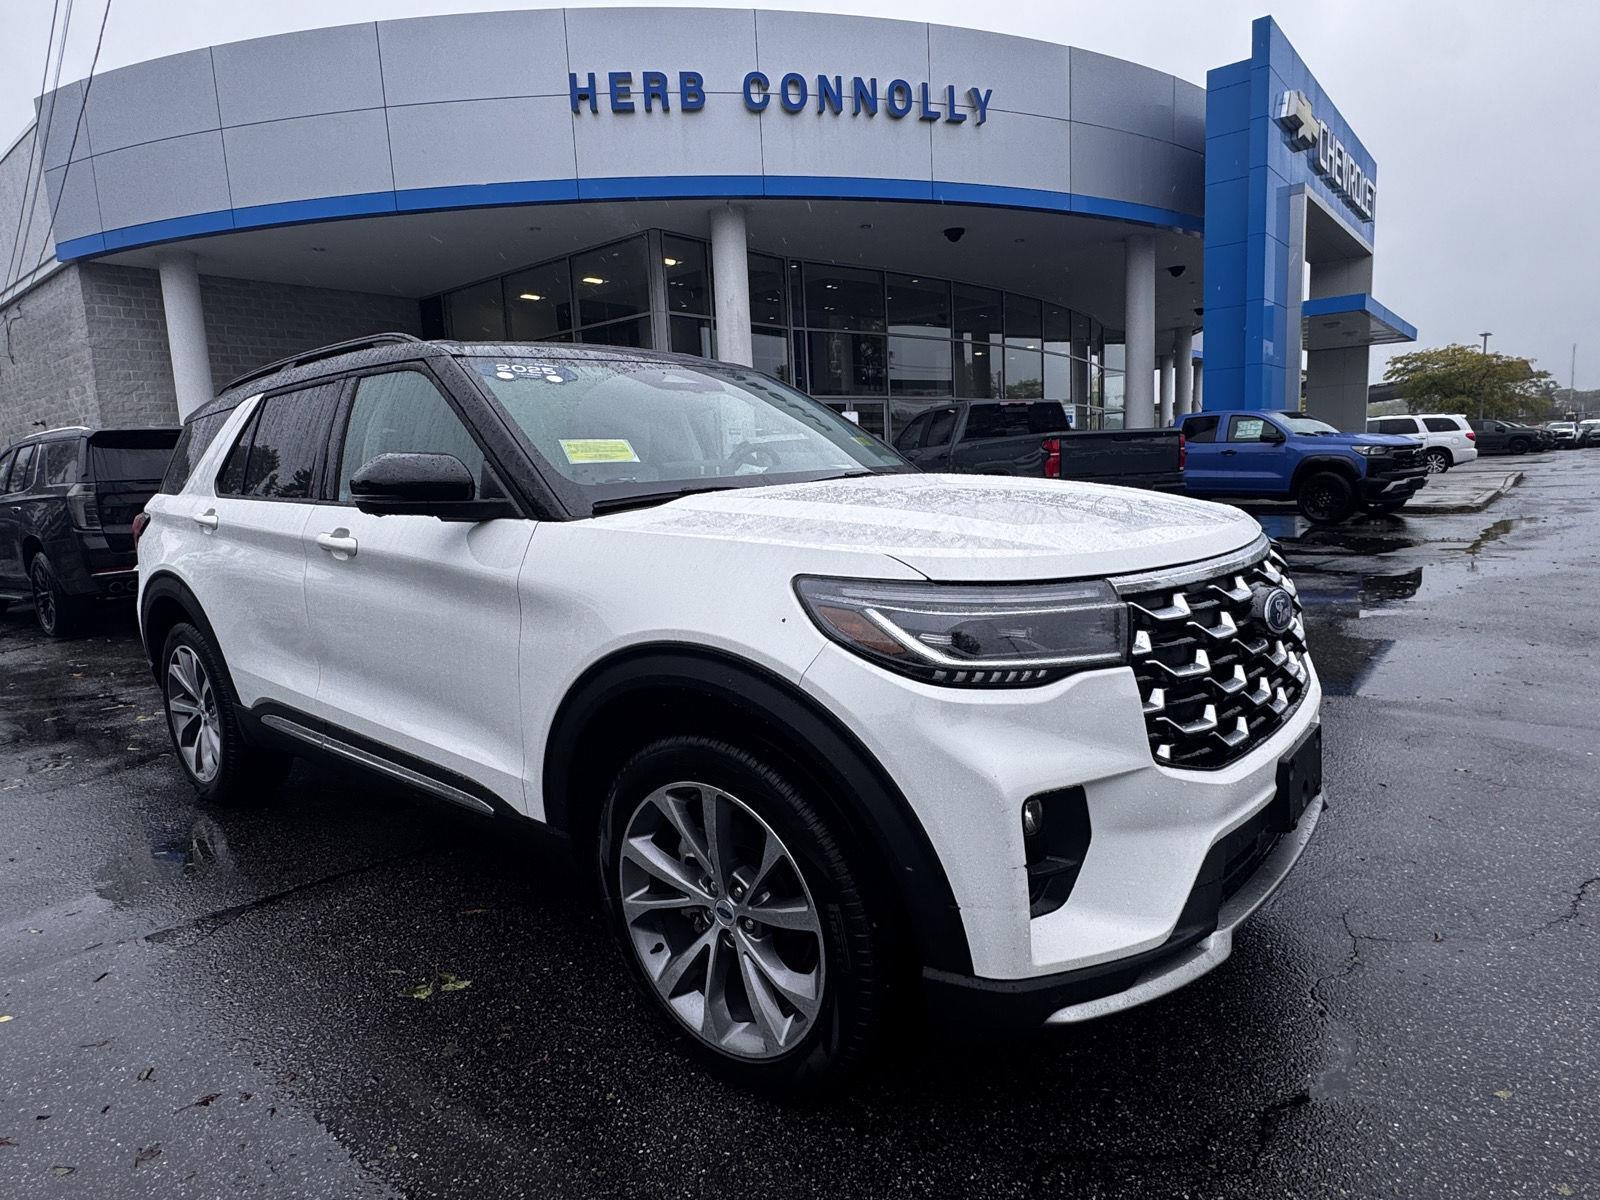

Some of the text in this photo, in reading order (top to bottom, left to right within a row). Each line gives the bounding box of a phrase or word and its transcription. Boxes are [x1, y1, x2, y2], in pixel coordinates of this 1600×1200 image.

[568, 71, 993, 125] HERB CONNOLLY
[495, 364, 557, 375] 2025
